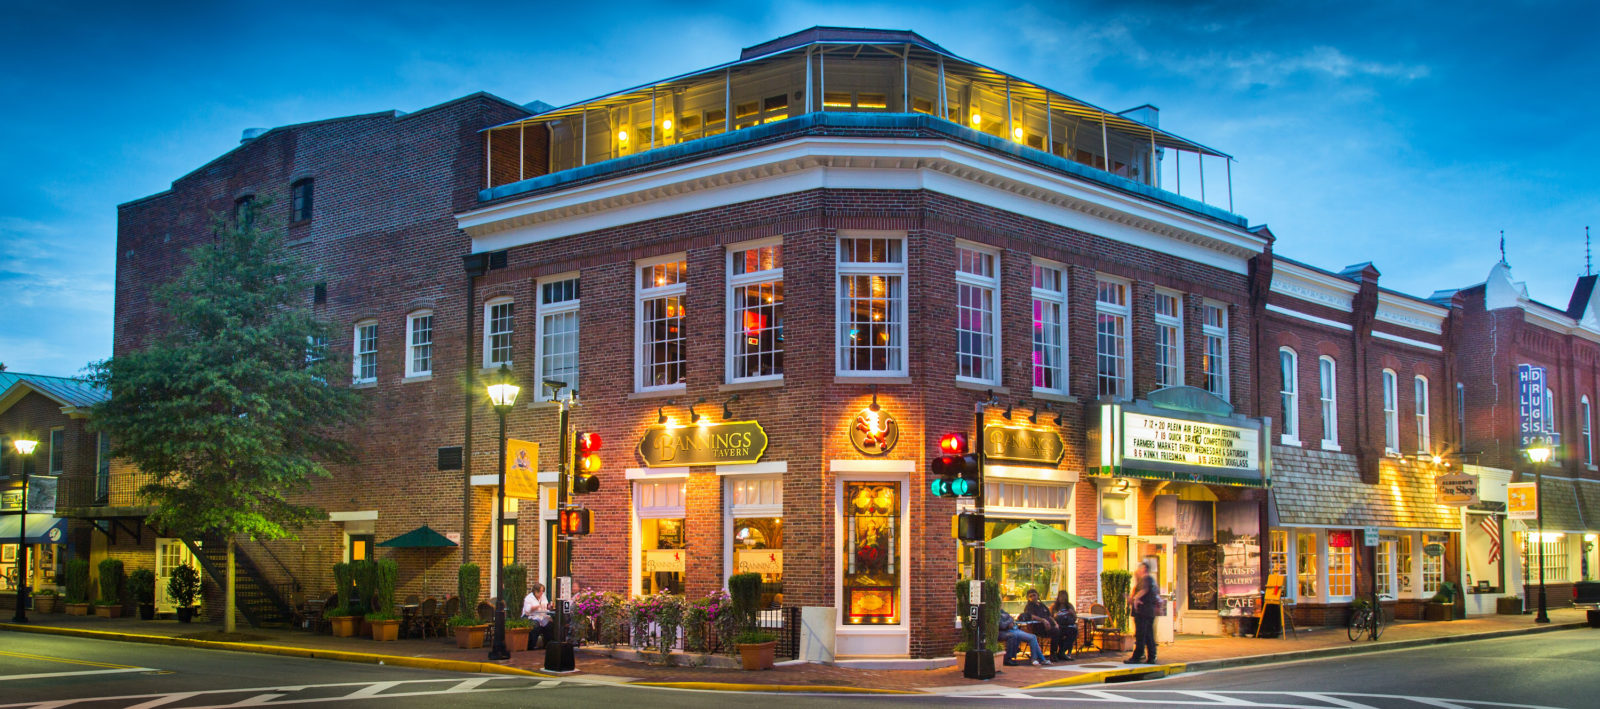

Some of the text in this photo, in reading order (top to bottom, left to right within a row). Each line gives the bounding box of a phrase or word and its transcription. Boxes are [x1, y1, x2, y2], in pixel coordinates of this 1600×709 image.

[1520, 371, 1529, 432] HILL'S
[1531, 371, 1540, 432] DRUGS
[1167, 422, 1182, 432] PLEIN
[1183, 424, 1192, 433] AIR
[1193, 425, 1211, 435] EASTON
[1212, 428, 1221, 436] ART
[1221, 429, 1241, 439] FESTIVAL
[654, 431, 752, 461] BANNINGS
[1168, 433, 1182, 442] QUICK
[1184, 434, 1201, 444] DRA
[1203, 436, 1233, 447] COMPETITION
[713, 447, 749, 457] TAVERN
[1133, 438, 1155, 448] FARMERS
[1157, 441, 1178, 451] MARKET
[1179, 443, 1193, 452] EVERY
[1195, 445, 1222, 456] WEDNESDAY
[1226, 449, 1249, 458] SATURDAY
[1144, 450, 1159, 459] KINKY
[1161, 451, 1186, 463] FRIEDMAN
[1208, 456, 1223, 466] JERRY
[1225, 458, 1249, 468] DOUGLASS
[1222, 567, 1255, 575] ARTISTS
